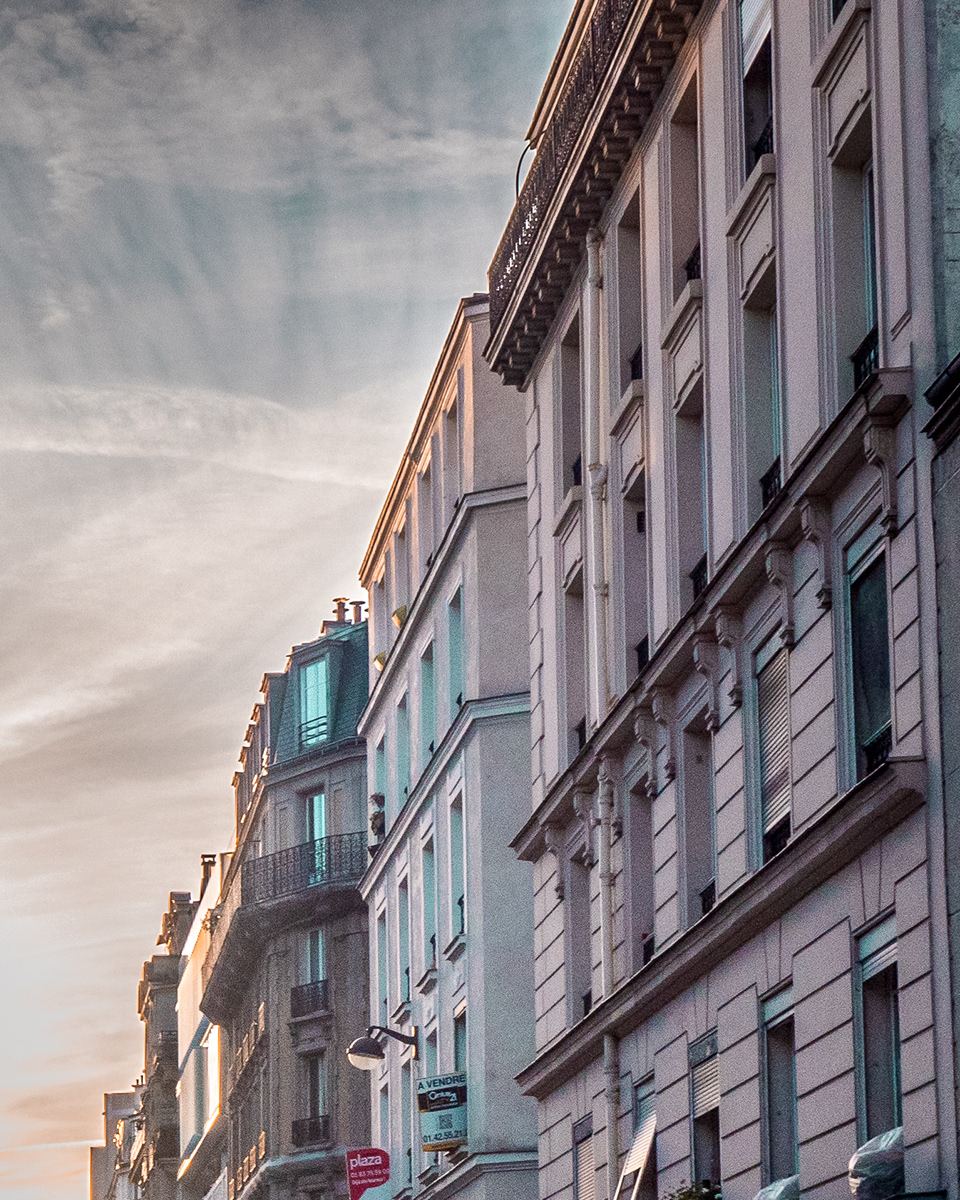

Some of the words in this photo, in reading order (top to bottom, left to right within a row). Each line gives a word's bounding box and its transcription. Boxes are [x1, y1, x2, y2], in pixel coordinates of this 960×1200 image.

[418, 1081, 424, 1090] A
[426, 1074, 466, 1088] VENDRE
[350, 1153, 382, 1170] plaza
